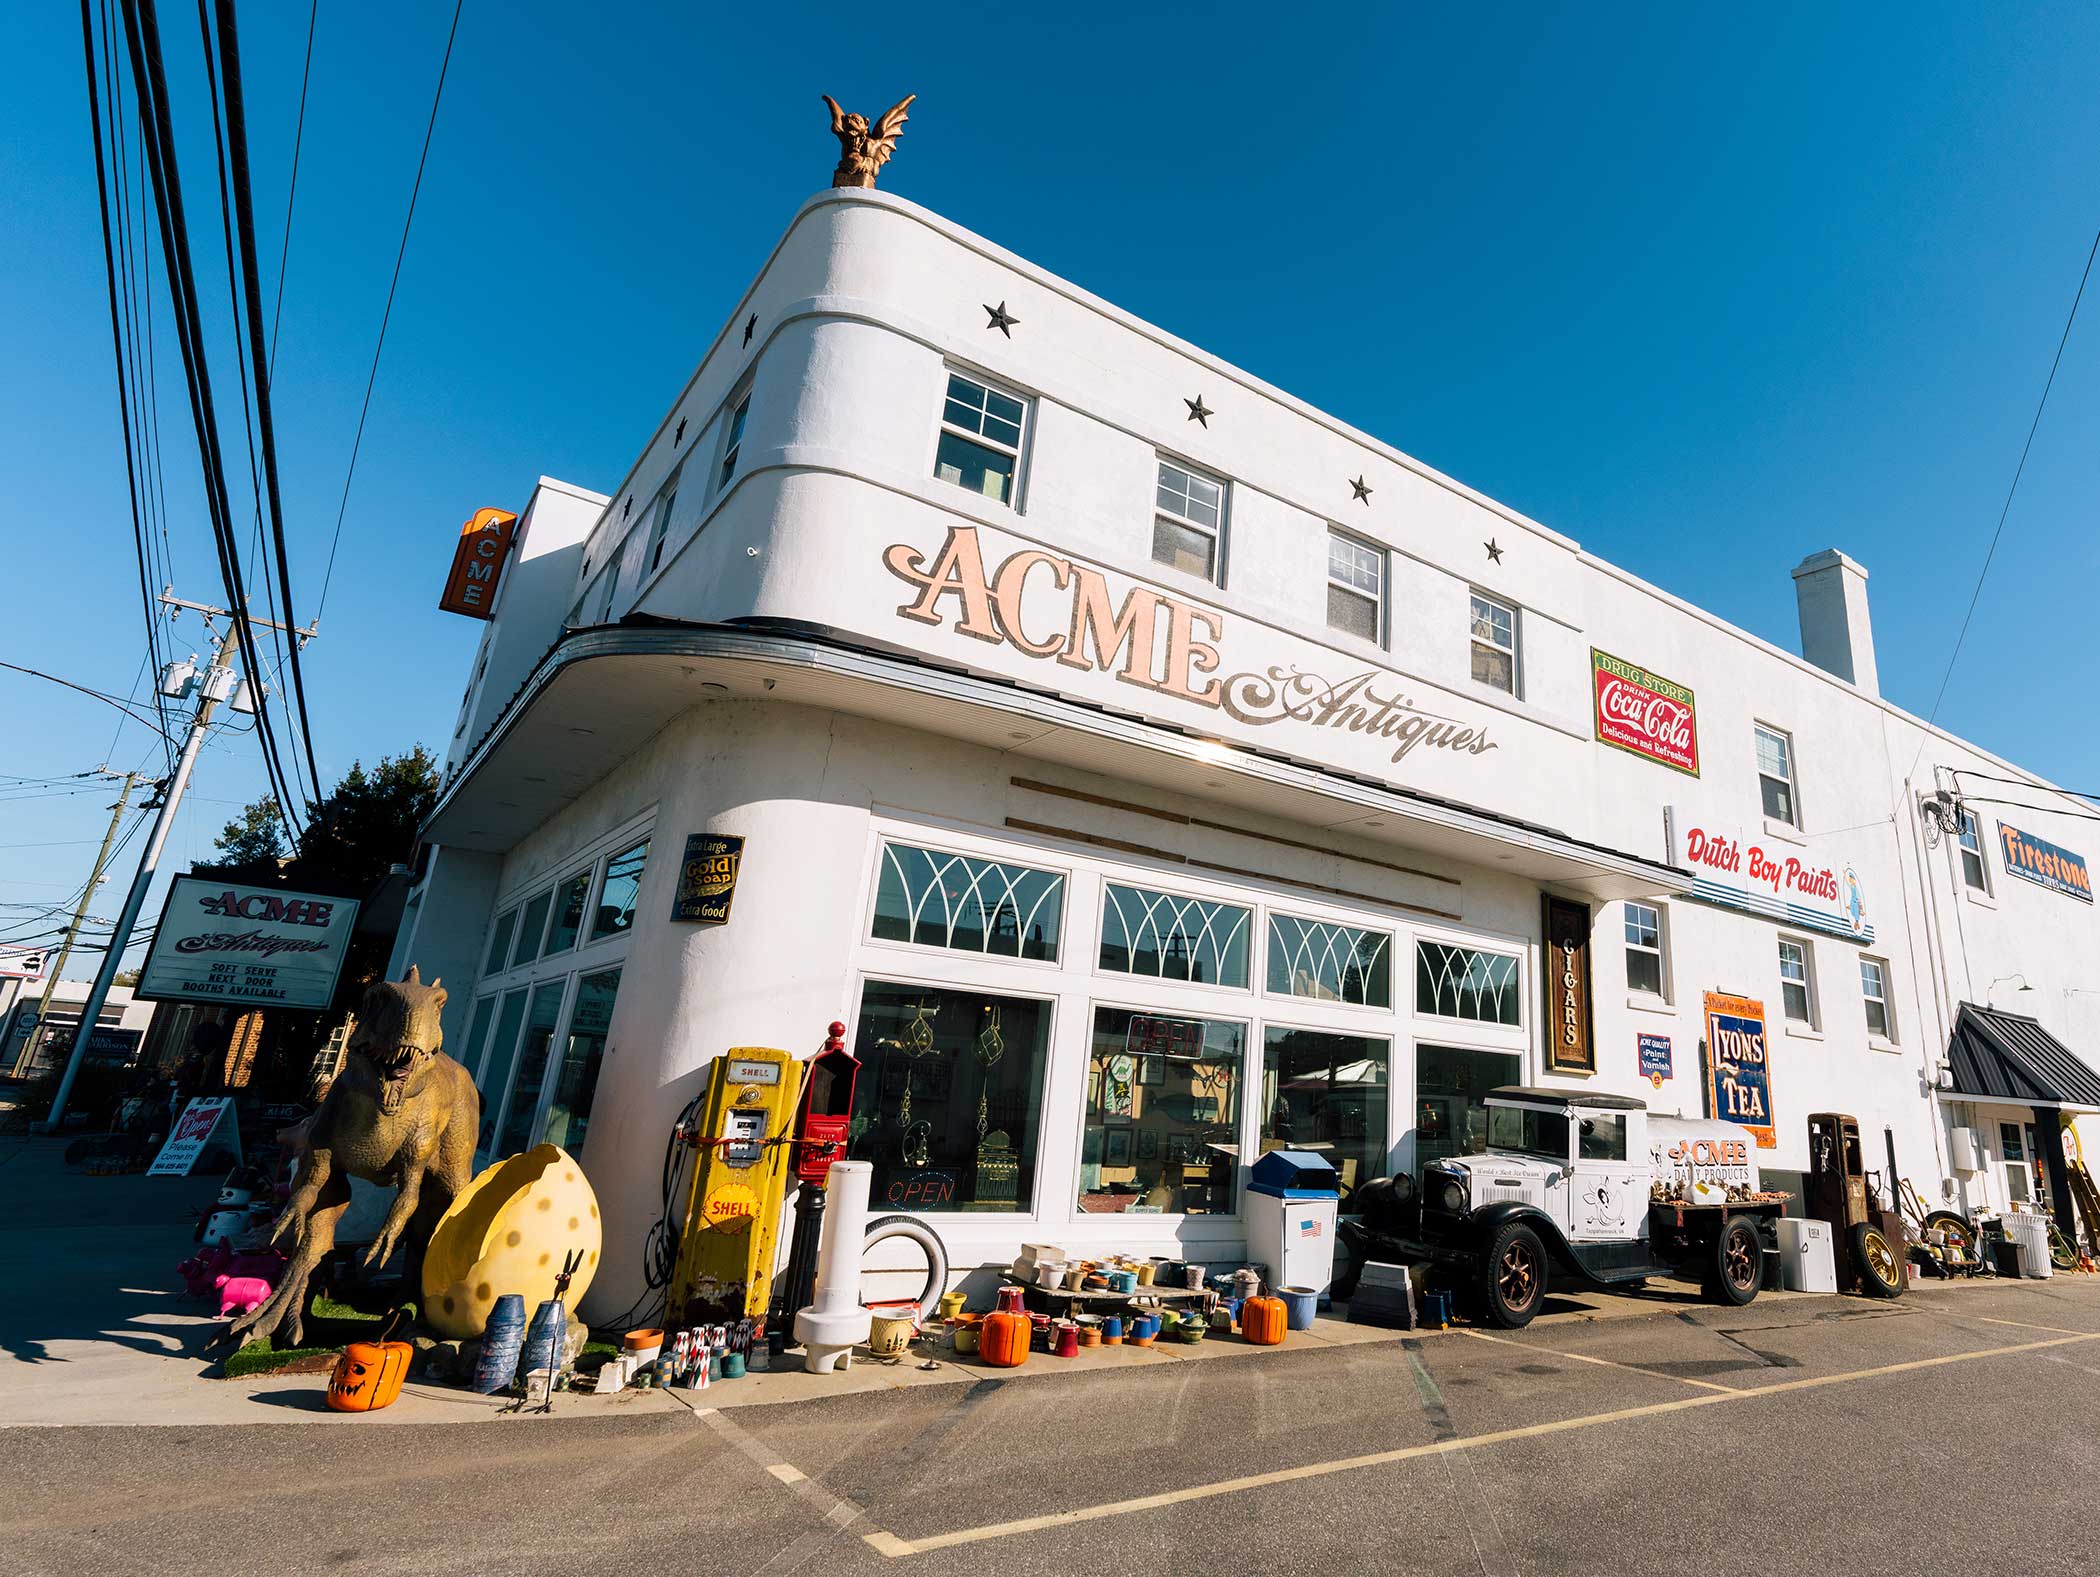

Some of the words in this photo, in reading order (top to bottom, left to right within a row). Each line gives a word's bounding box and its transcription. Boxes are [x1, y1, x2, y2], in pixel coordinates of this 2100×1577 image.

[463, 516, 502, 605] ACME
[882, 526, 1223, 709] ACME
[1602, 657, 1640, 683] DRUG
[1643, 676, 1686, 702] STORE
[1622, 683, 1651, 700] DRINK
[1220, 664, 1499, 763] Antiques
[1600, 680, 1692, 750] Coca-Cola
[1602, 722, 1639, 745] Delicious
[1639, 739, 1653, 750] and
[1654, 742, 1693, 768] Refreshing
[687, 840, 702, 851] Extra
[703, 840, 728, 854] Large
[687, 857, 730, 877] Gold
[1687, 828, 1741, 873] Dutch
[1747, 846, 1783, 894] Boy
[1785, 857, 1838, 901] Paints
[2001, 825, 2091, 892] Firestone
[695, 874, 731, 885] Soap
[199, 891, 334, 927] ACME
[681, 903, 700, 916] Extra
[701, 904, 726, 918] Good
[175, 929, 330, 958] Antiques
[209, 973, 235, 985] NEXT
[245, 976, 274, 987] DOOR
[211, 963, 239, 974] SOFT
[245, 965, 278, 977] SERVE
[182, 982, 225, 994] BOOTHS
[228, 985, 287, 999] AVAILABLE
[1563, 938, 1577, 1045] CIGARS
[1130, 1019, 1204, 1057] OPEN
[1651, 1040, 1670, 1049] QUALITY
[741, 1067, 770, 1077] SHELL
[1641, 1060, 1670, 1071] Varnish
[1722, 1077, 1766, 1117] TEA
[161, 1153, 183, 1161] Come
[168, 1143, 198, 1151] Please
[1668, 1140, 1748, 1166] ACME
[1674, 1168, 1701, 1181] DAIY
[1704, 1168, 1749, 1181] PRODUCTS
[888, 1181, 955, 1202] OPEN
[711, 1200, 752, 1217] SHELL
